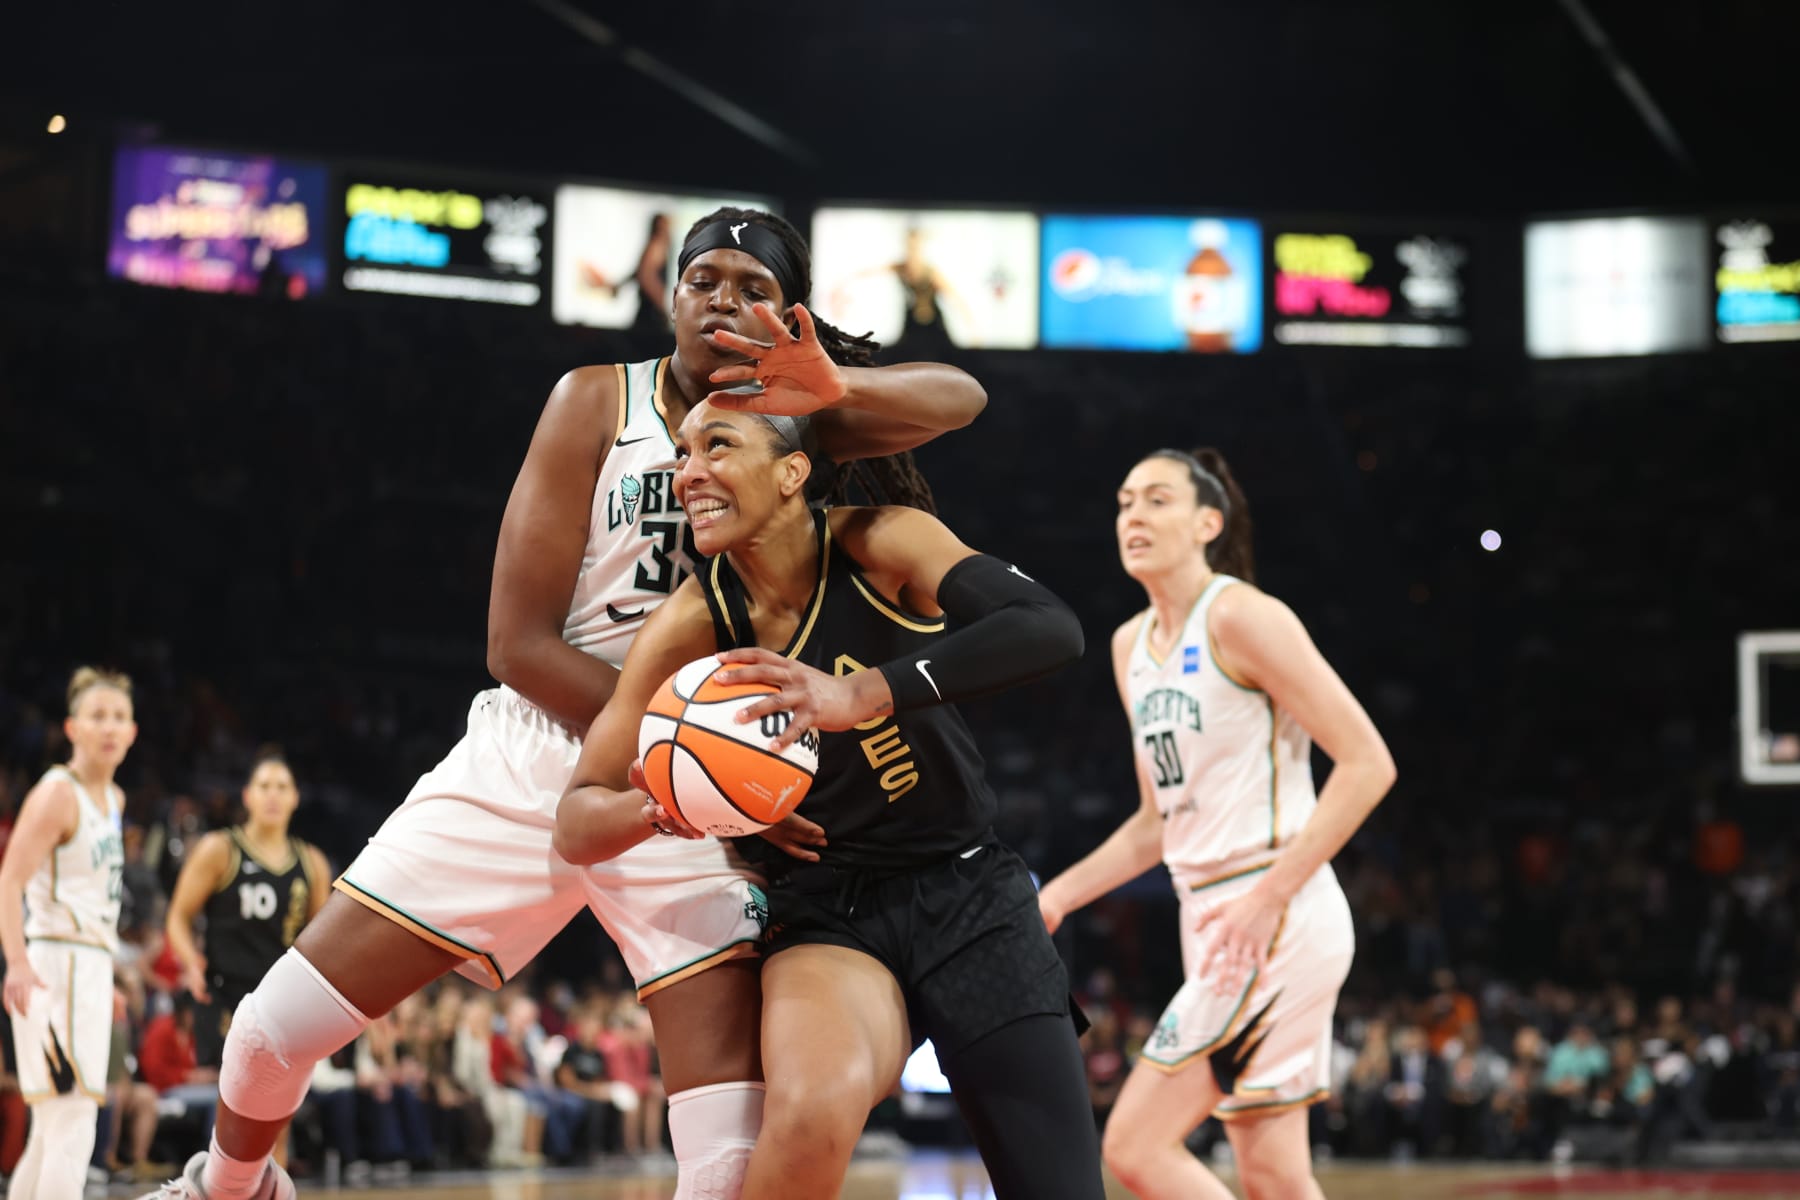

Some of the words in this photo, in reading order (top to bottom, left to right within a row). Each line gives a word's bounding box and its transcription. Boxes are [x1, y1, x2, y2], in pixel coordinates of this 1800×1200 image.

[834, 654, 919, 803] AES
[1145, 730, 1184, 788] 30
[238, 882, 278, 920] 10
